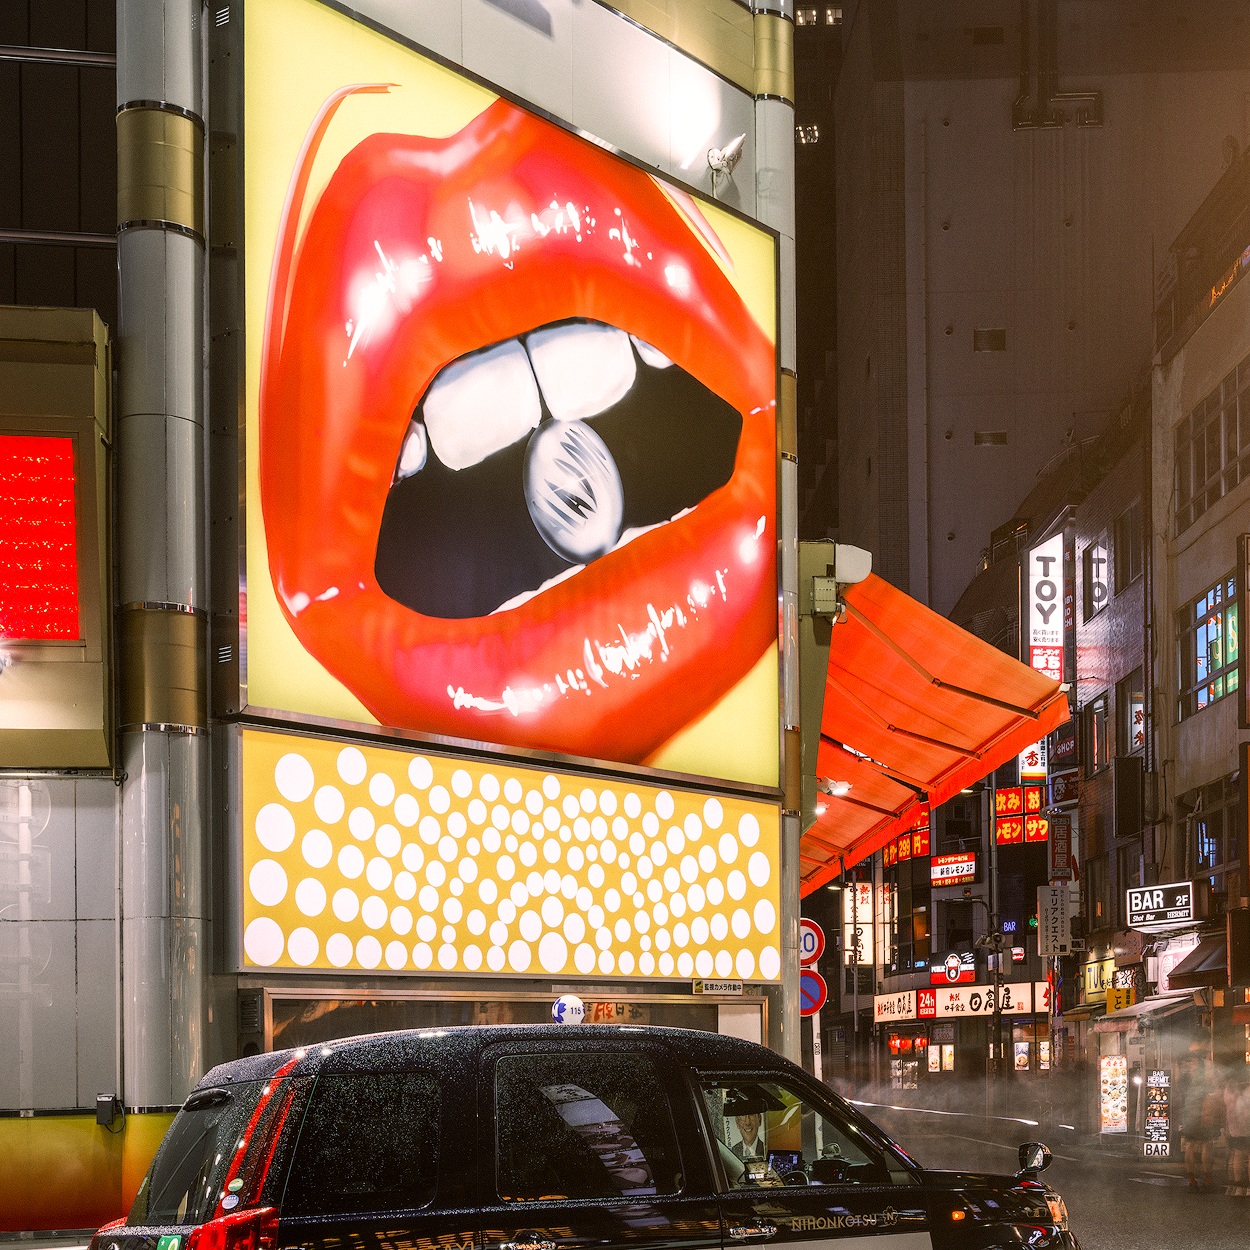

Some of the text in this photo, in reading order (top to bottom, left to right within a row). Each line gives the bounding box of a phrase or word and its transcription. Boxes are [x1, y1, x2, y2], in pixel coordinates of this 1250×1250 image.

[1035, 556, 1057, 625] TOY
[1054, 826, 1068, 869] 居酒屋
[1131, 890, 1188, 911] BAR 2F
[1050, 890, 1059, 952] エリアクエスト
[1146, 913, 1155, 921] Bar
[1004, 921, 1016, 932] BAR
[705, 983, 741, 991] 監視カメラ作動中
[920, 993, 935, 1007] 24h
[1146, 1144, 1167, 1155] BAR
[792, 1214, 877, 1231] NIHONKOTSU
